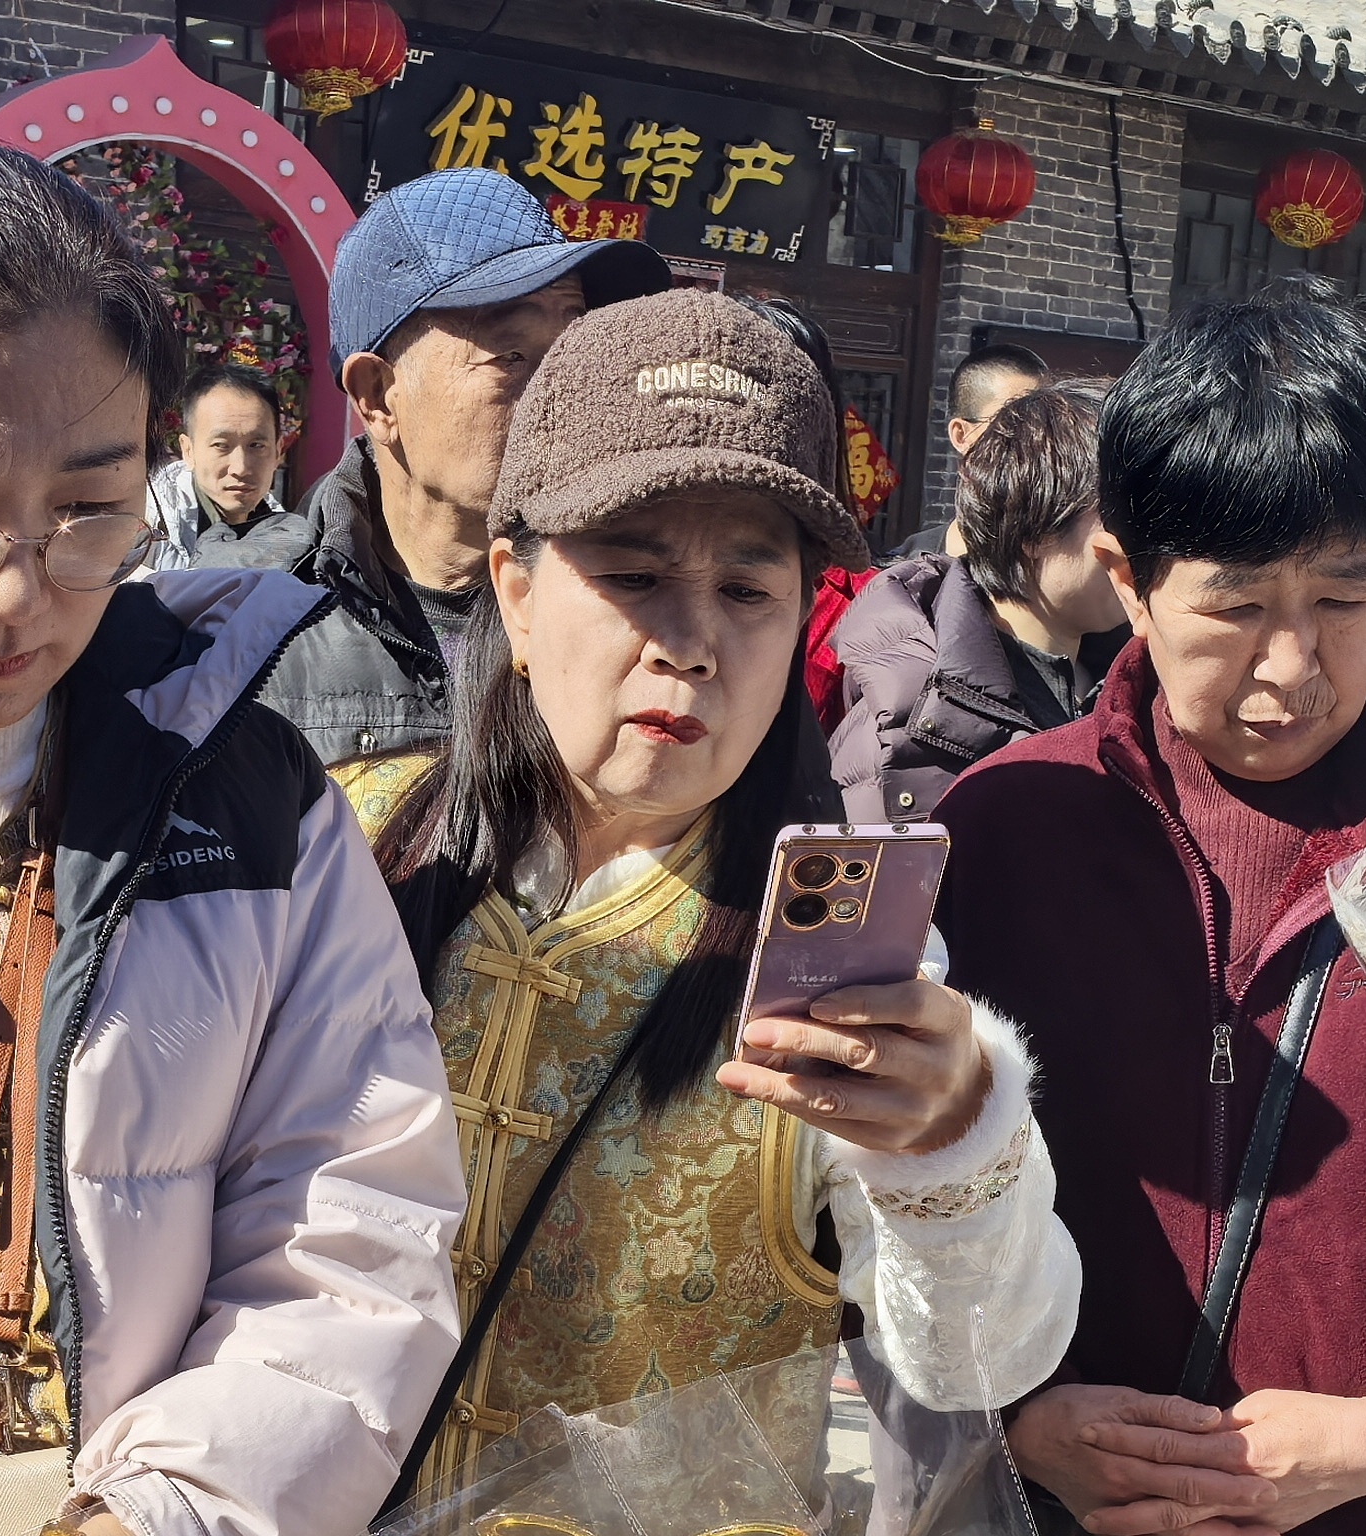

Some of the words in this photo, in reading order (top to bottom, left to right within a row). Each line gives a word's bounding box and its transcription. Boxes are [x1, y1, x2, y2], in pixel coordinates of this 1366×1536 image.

[424, 83, 796, 216] 优选特产
[701, 224, 770, 254] 巧克力
